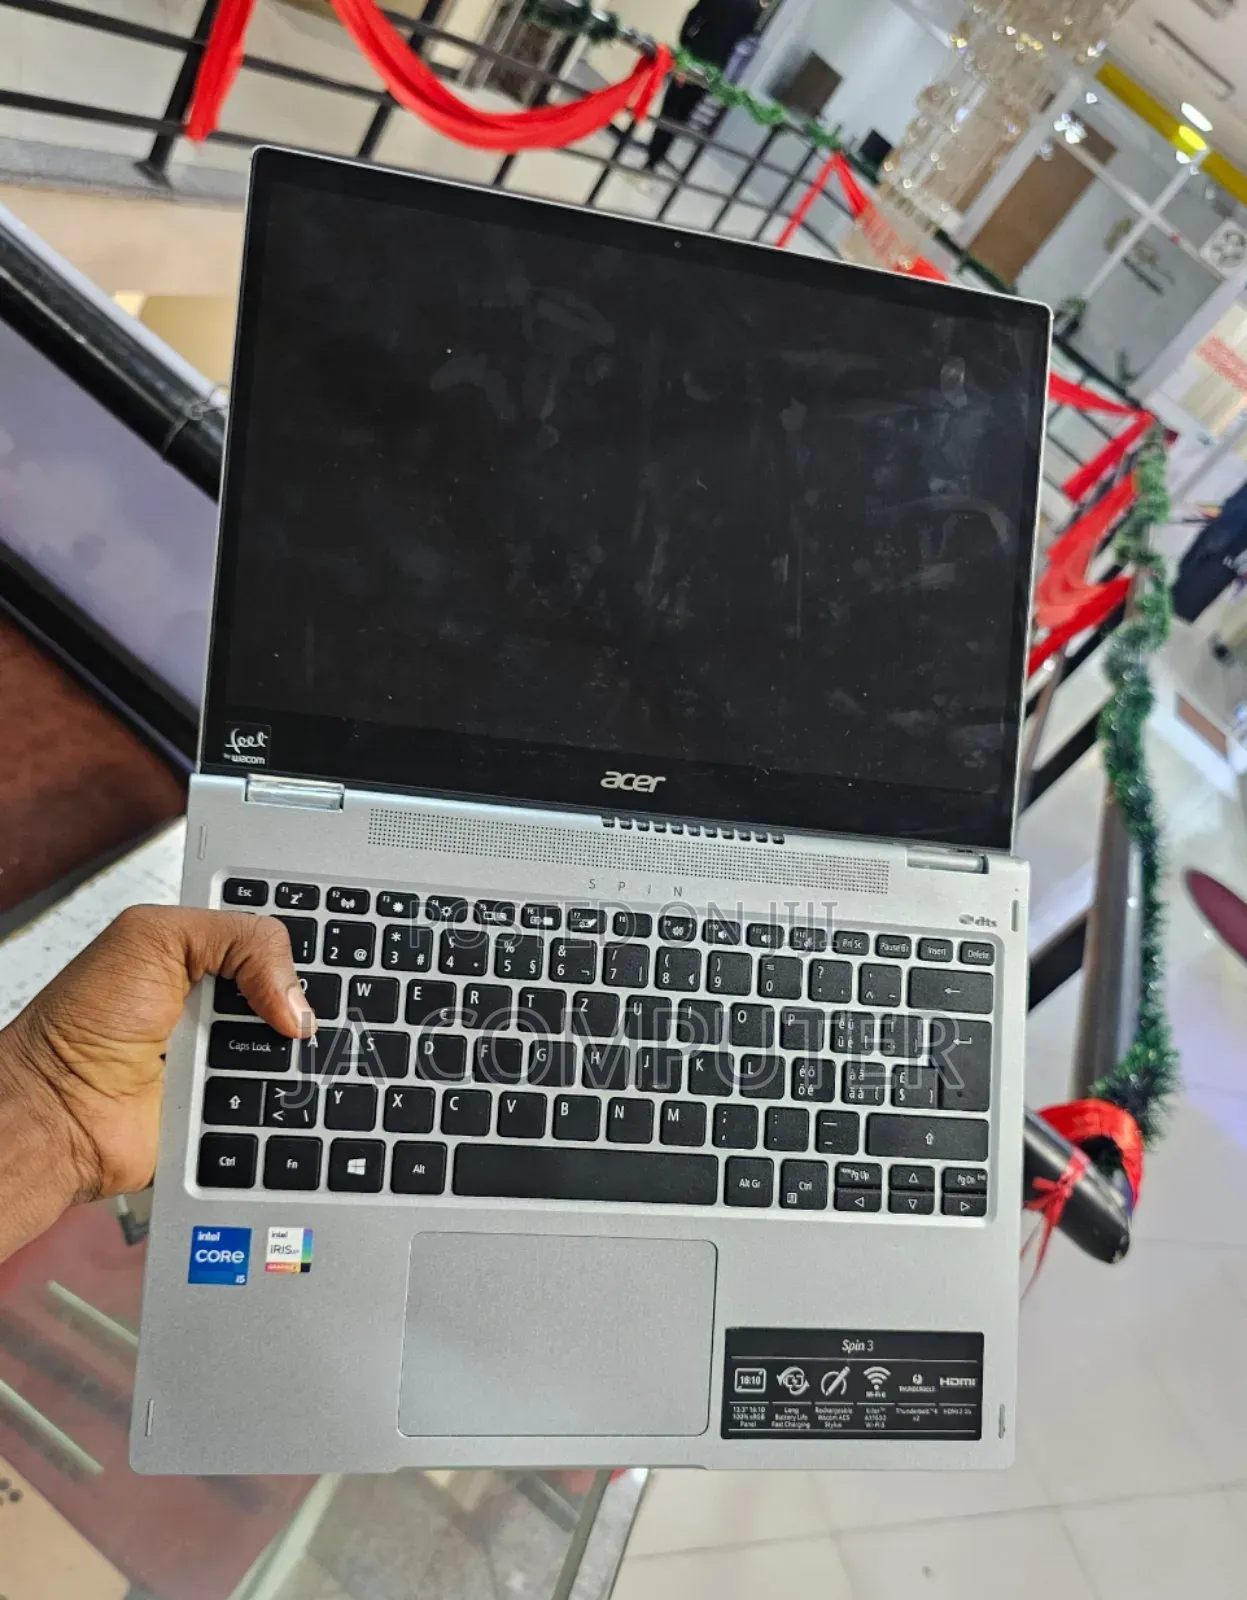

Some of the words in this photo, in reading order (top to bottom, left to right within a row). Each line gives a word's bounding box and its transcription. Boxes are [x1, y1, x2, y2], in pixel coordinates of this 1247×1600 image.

[600, 770, 667, 793] acer
[237, 886, 252, 897] Esc
[329, 946, 339, 960] 2
[353, 949, 368, 962] @
[928, 946, 946, 956] Insert
[967, 949, 990, 960] Delete
[390, 951, 399, 965] 3
[445, 955, 455, 968] 4
[503, 960, 512, 973] 5
[556, 964, 566, 977] 6
[609, 968, 617, 980] 7
[661, 972, 671, 985] 8
[713, 976, 722, 989] 9
[765, 980, 774, 993] 0
[356, 982, 372, 997] W
[413, 986, 422, 1001] E
[470, 990, 480, 1005] R
[526, 994, 535, 1008] T
[580, 998, 589, 1012] Z
[633, 1002, 643, 1016] U
[787, 1014, 796, 1027] P
[228, 1039, 250, 1052] Caps
[252, 1041, 272, 1053] Lock
[307, 1033, 319, 1049] A
[366, 1037, 375, 1052] S
[424, 1041, 434, 1055] D
[481, 1044, 489, 1058] F
[536, 1048, 547, 1062] G
[590, 1052, 600, 1065] H
[643, 1056, 650, 1069] J
[695, 1058, 705, 1072] K
[747, 1062, 754, 1075] L
[334, 1090, 343, 1104] Y
[392, 1093, 403, 1108] X
[449, 1096, 459, 1111] C
[506, 1100, 517, 1114] V
[561, 1102, 569, 1116] B
[614, 1105, 625, 1119] N
[667, 1108, 680, 1122] M
[218, 1156, 236, 1167] Ctrl
[287, 1159, 298, 1170] Fn
[412, 1164, 426, 1175] Alt
[850, 1170, 859, 1181] Pg
[859, 1170, 870, 1182] Up
[738, 1177, 750, 1189] Alt
[751, 1178, 761, 1189] Gr
[799, 1180, 812, 1191] Ctrl
[957, 1174, 966, 1186] Pg
[197, 1231, 220, 1242] intel
[235, 1274, 246, 1284] i5
[842, 1339, 865, 1353] Spin
[867, 1339, 874, 1351] 3
[784, 1407, 800, 1415] Long
[740, 1420, 757, 1428] Panel
